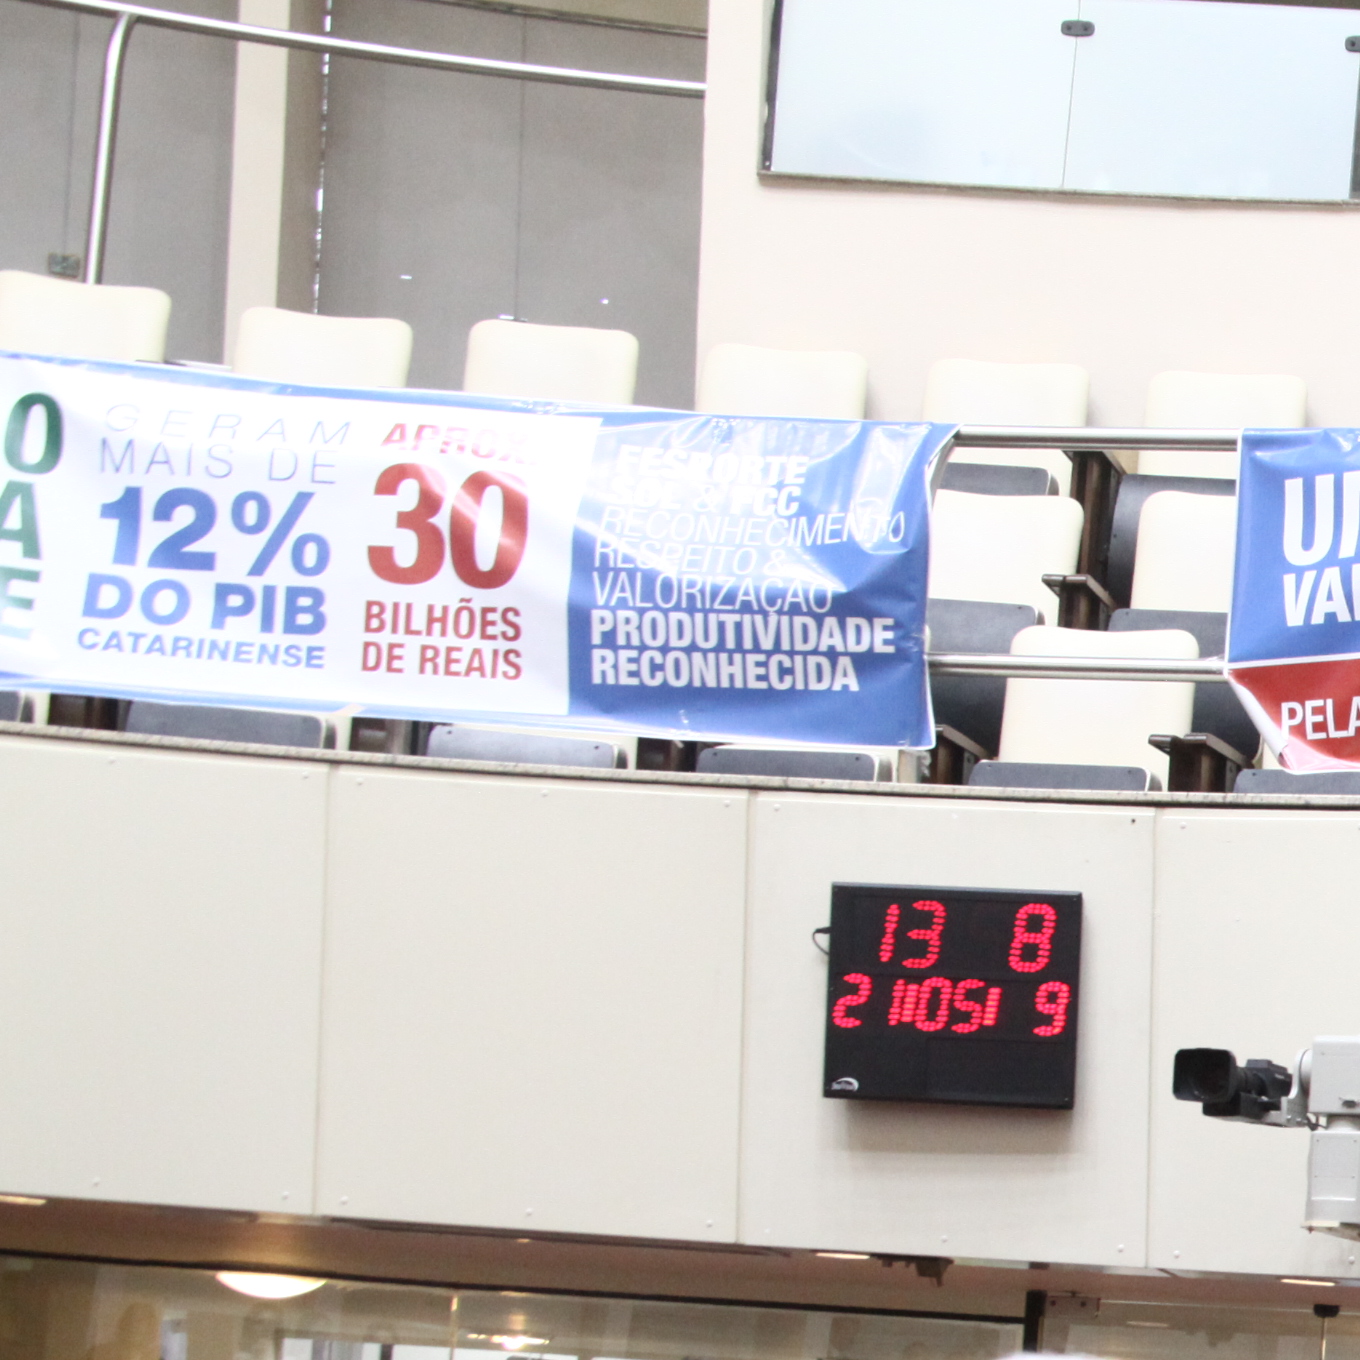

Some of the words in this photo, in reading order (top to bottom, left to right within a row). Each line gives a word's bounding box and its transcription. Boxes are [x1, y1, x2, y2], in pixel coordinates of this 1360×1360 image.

[105, 403, 351, 446] GERAM
[100, 437, 234, 479] MAIS
[268, 447, 337, 485] DE
[616, 445, 809, 486] FESPORTE
[607, 476, 682, 510] SOL
[693, 483, 718, 512] &
[729, 486, 802, 517] FCC
[99, 486, 332, 577] 12%
[367, 462, 529, 590] 30
[601, 507, 906, 547] RECONHECIMENTO
[594, 536, 756, 575] RESPEITO
[763, 552, 790, 576] &
[81, 573, 192, 626] DO
[210, 582, 327, 636] PIB
[364, 597, 521, 642] BILHÕES
[77, 627, 326, 669] CATARINENSE
[590, 609, 896, 654] PRODUTIVIDADE
[361, 641, 405, 675] DE
[419, 644, 522, 681] REAIS
[591, 649, 860, 692] RECONHECIDA
[1008, 903, 1057, 973] 8
